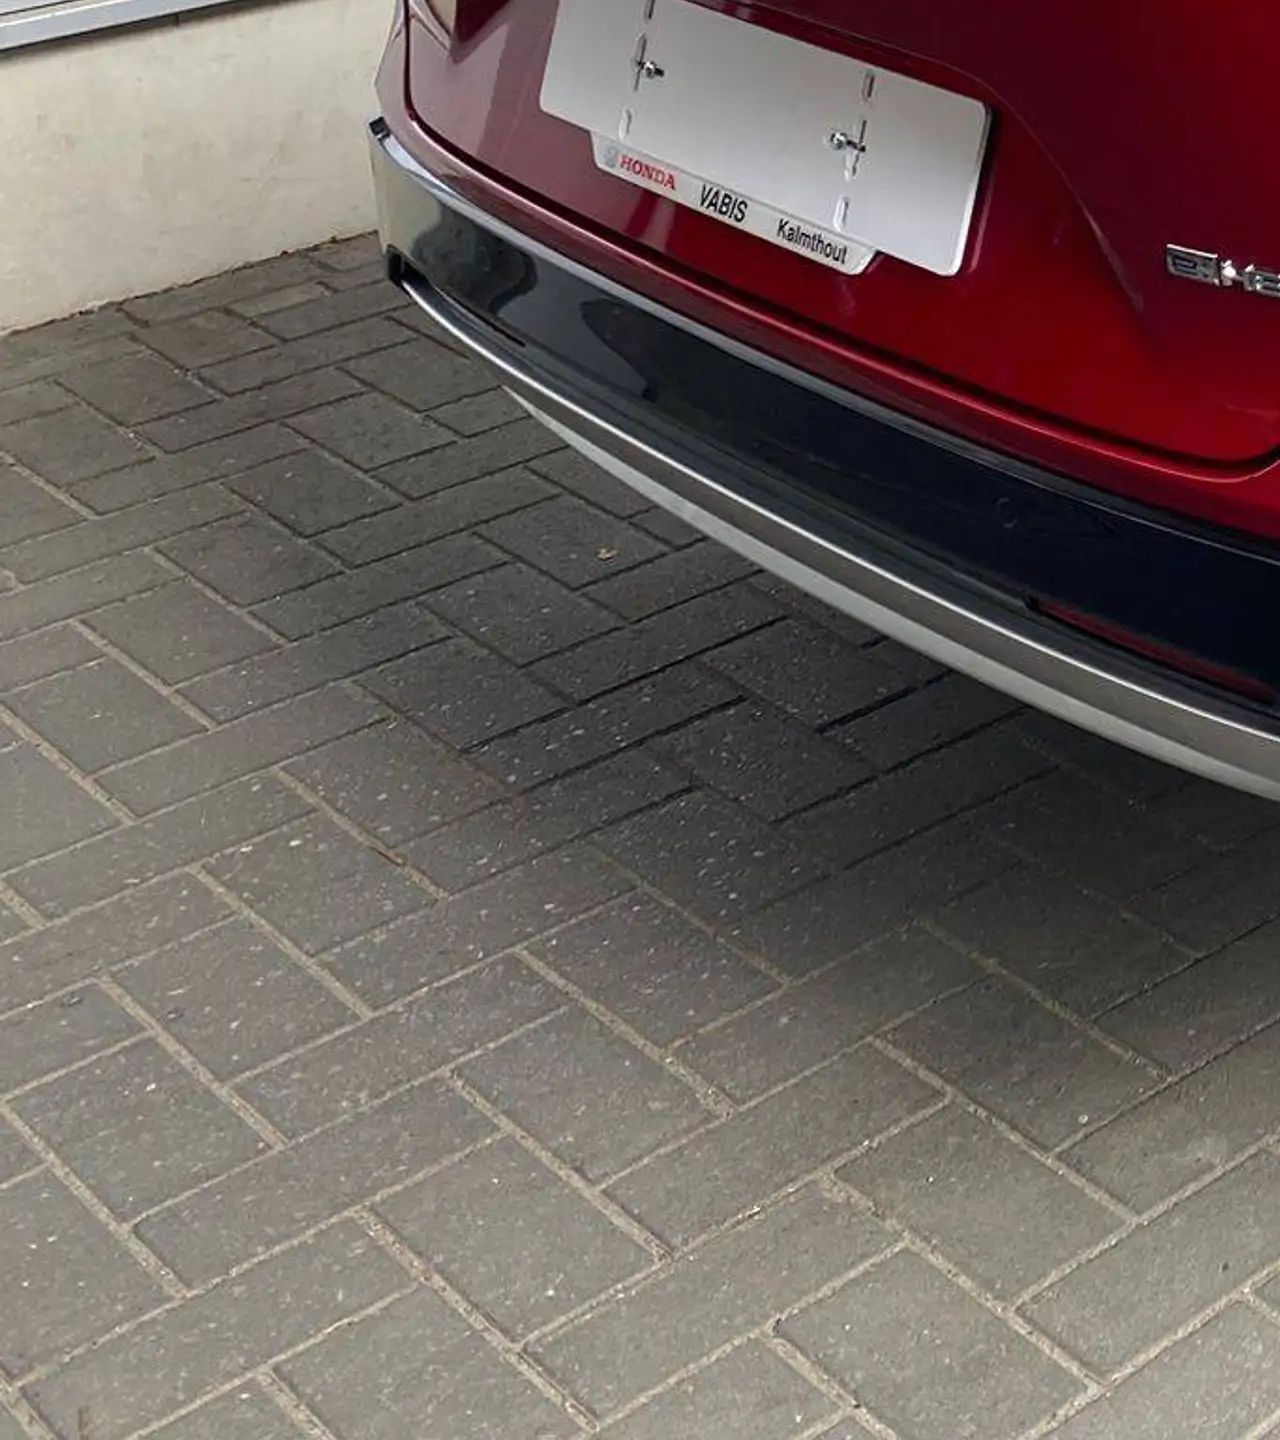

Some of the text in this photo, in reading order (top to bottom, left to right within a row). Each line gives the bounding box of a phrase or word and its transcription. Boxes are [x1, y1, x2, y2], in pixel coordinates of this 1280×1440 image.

[619, 154, 849, 265] HONDA VABIS Kalmthout
